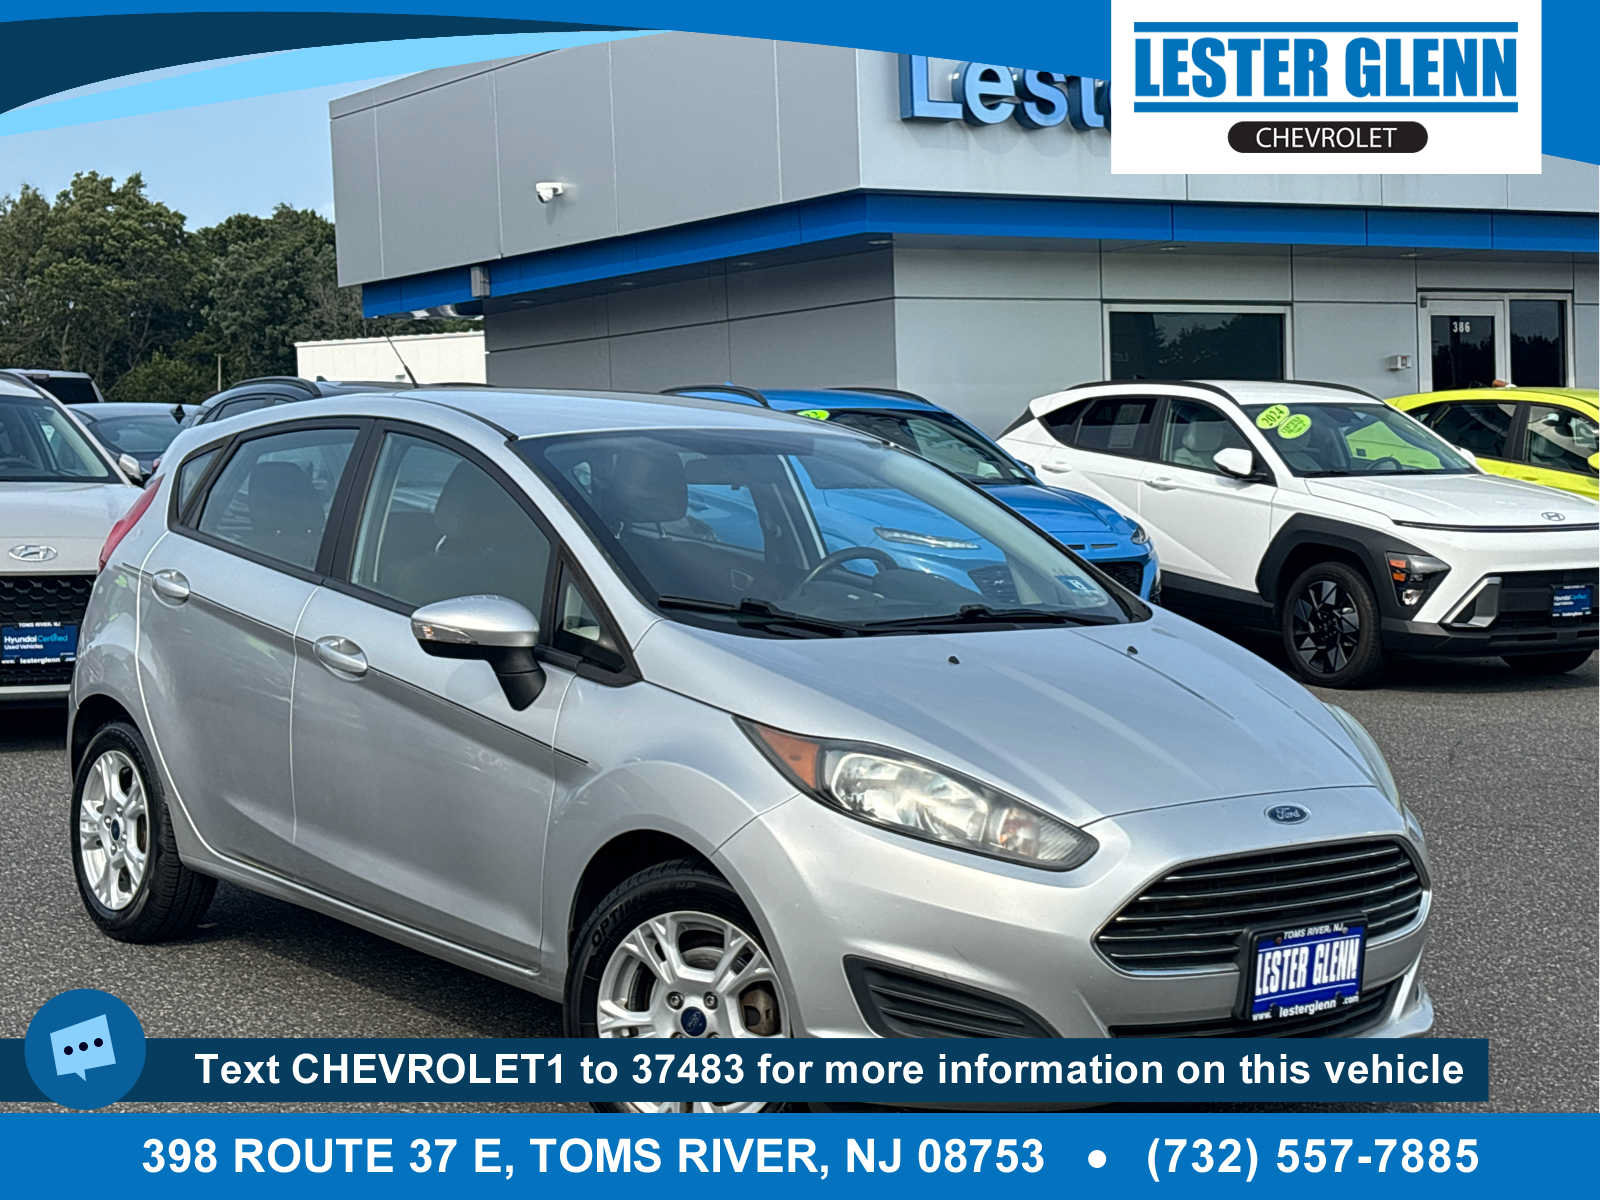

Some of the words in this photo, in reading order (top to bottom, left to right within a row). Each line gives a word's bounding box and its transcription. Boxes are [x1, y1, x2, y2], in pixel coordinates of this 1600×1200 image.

[1261, 407, 1284, 426] 2024
[4, 635, 37, 644] Hyundai
[1283, 928, 1306, 939] TOMS
[1255, 946, 1310, 996] LESTER
[1312, 938, 1360, 985] GLENN
[1279, 999, 1337, 1017] lesterglenn
